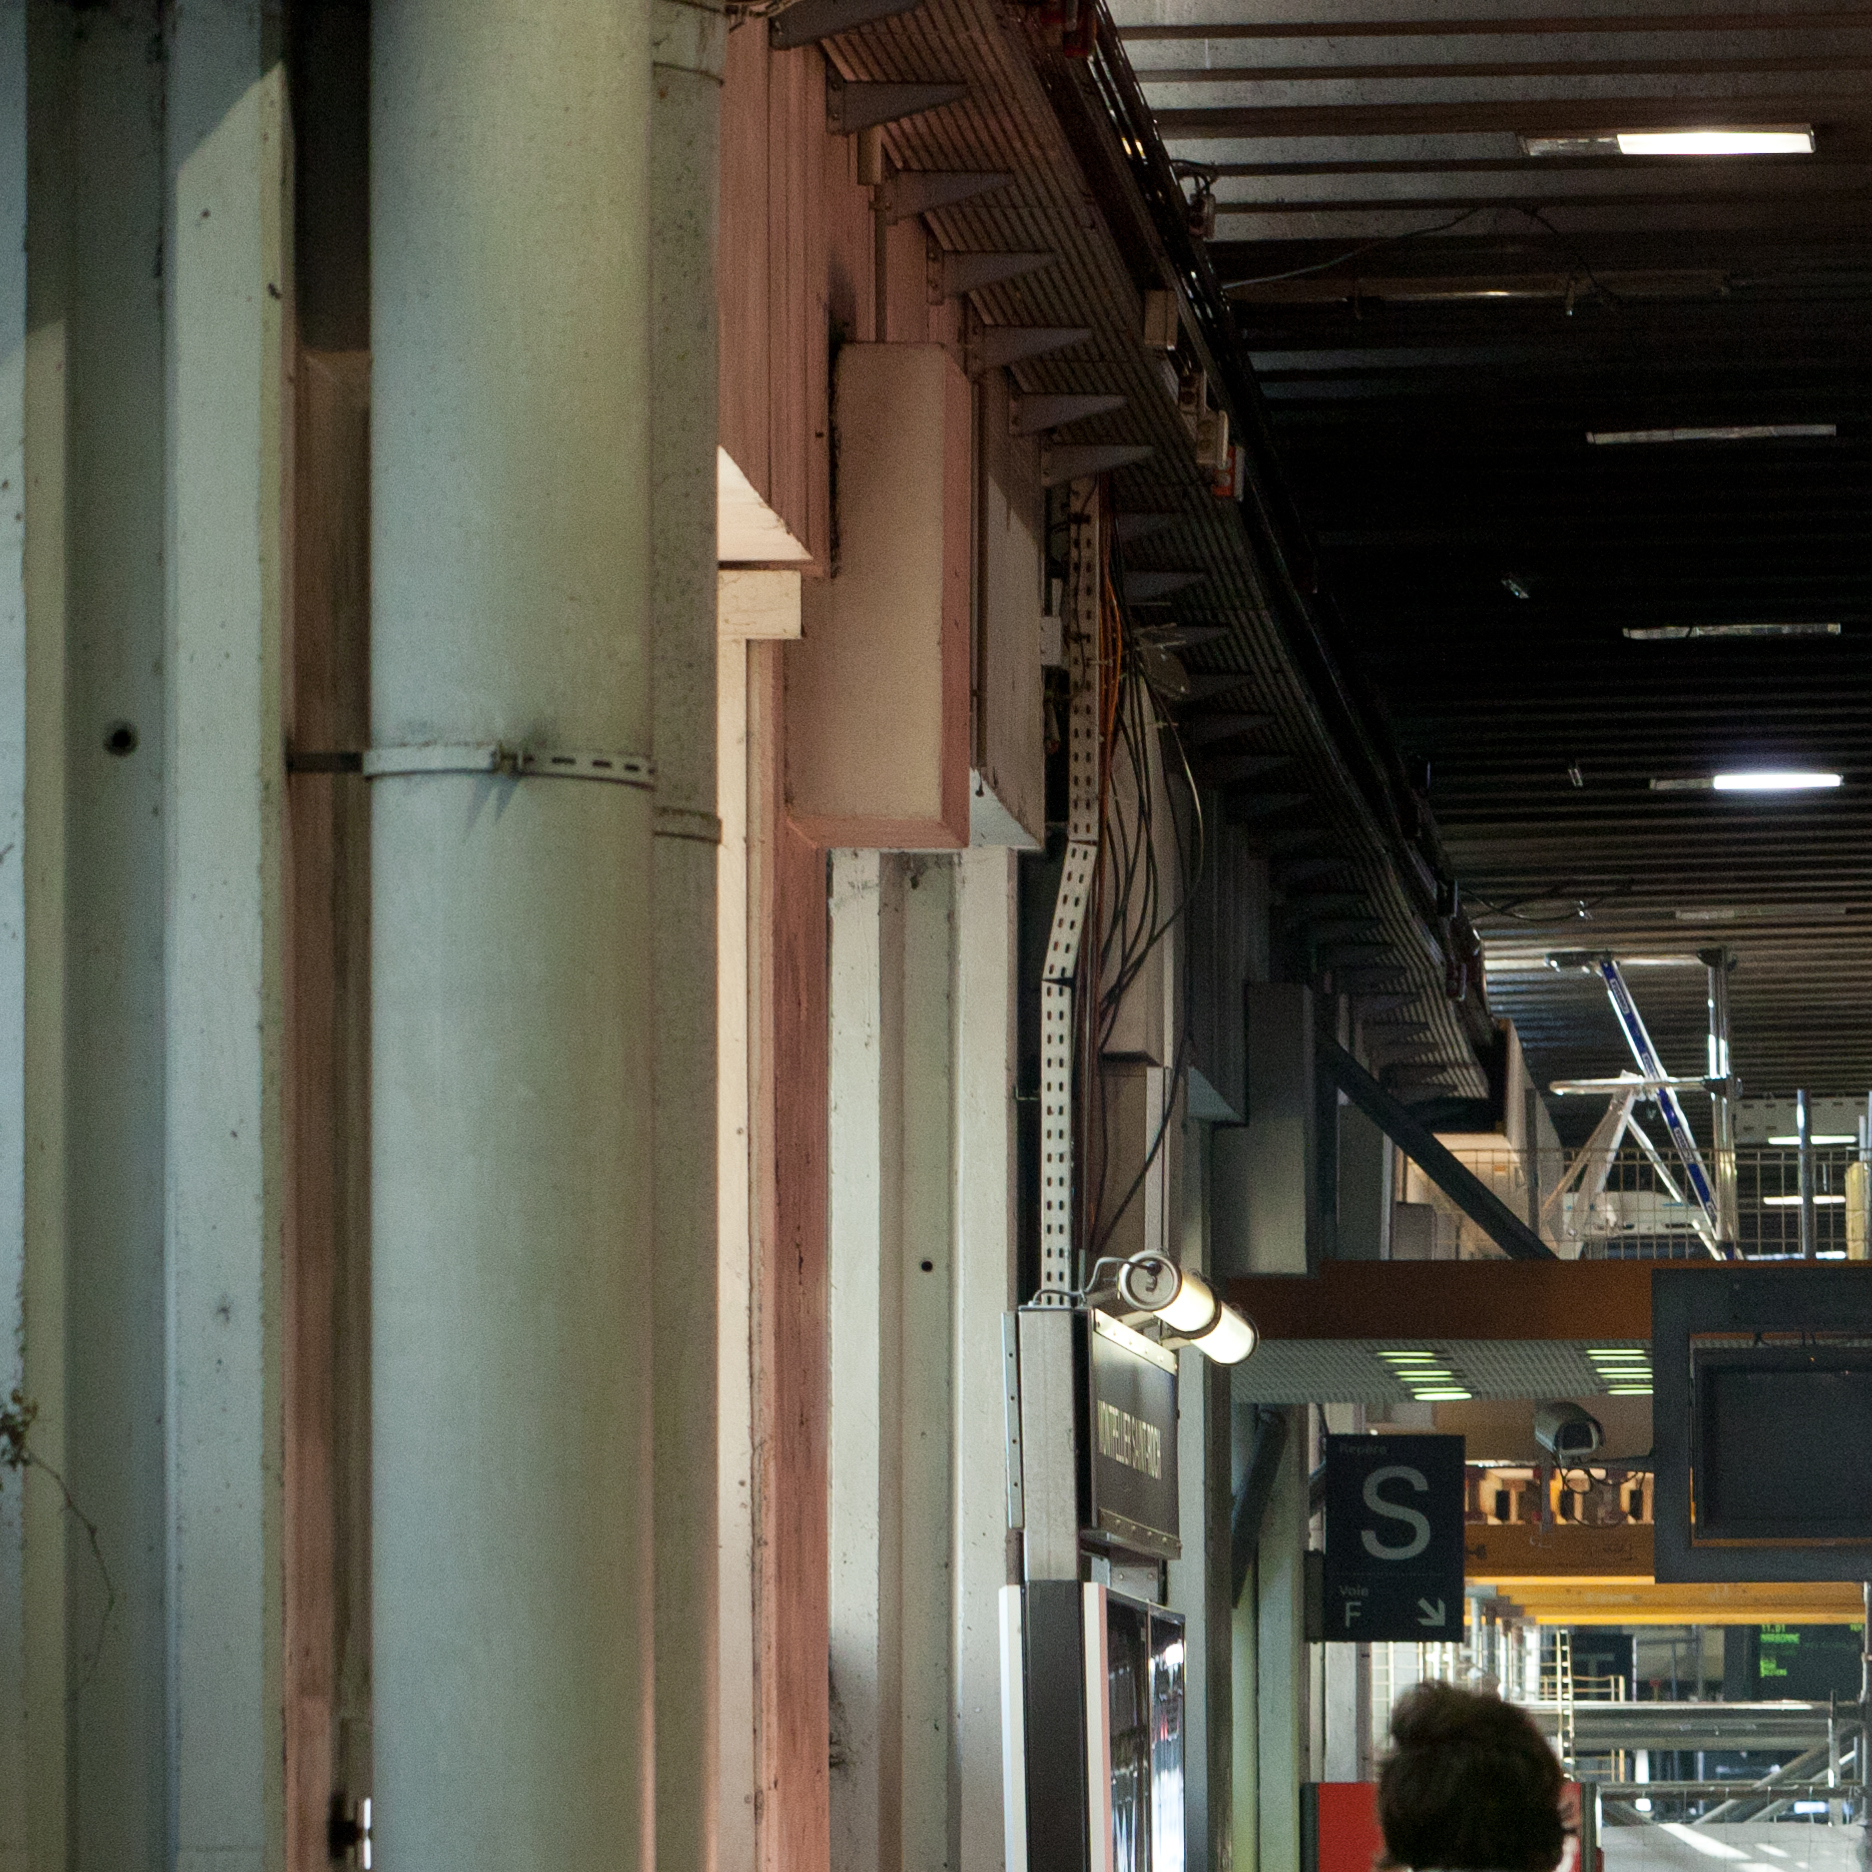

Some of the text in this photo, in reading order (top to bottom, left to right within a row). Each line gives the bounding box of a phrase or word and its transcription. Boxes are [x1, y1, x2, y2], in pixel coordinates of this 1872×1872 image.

[1361, 1465, 1431, 1561] S
[1339, 1585, 1369, 1597] Voie
[1345, 1602, 1362, 1628] F
